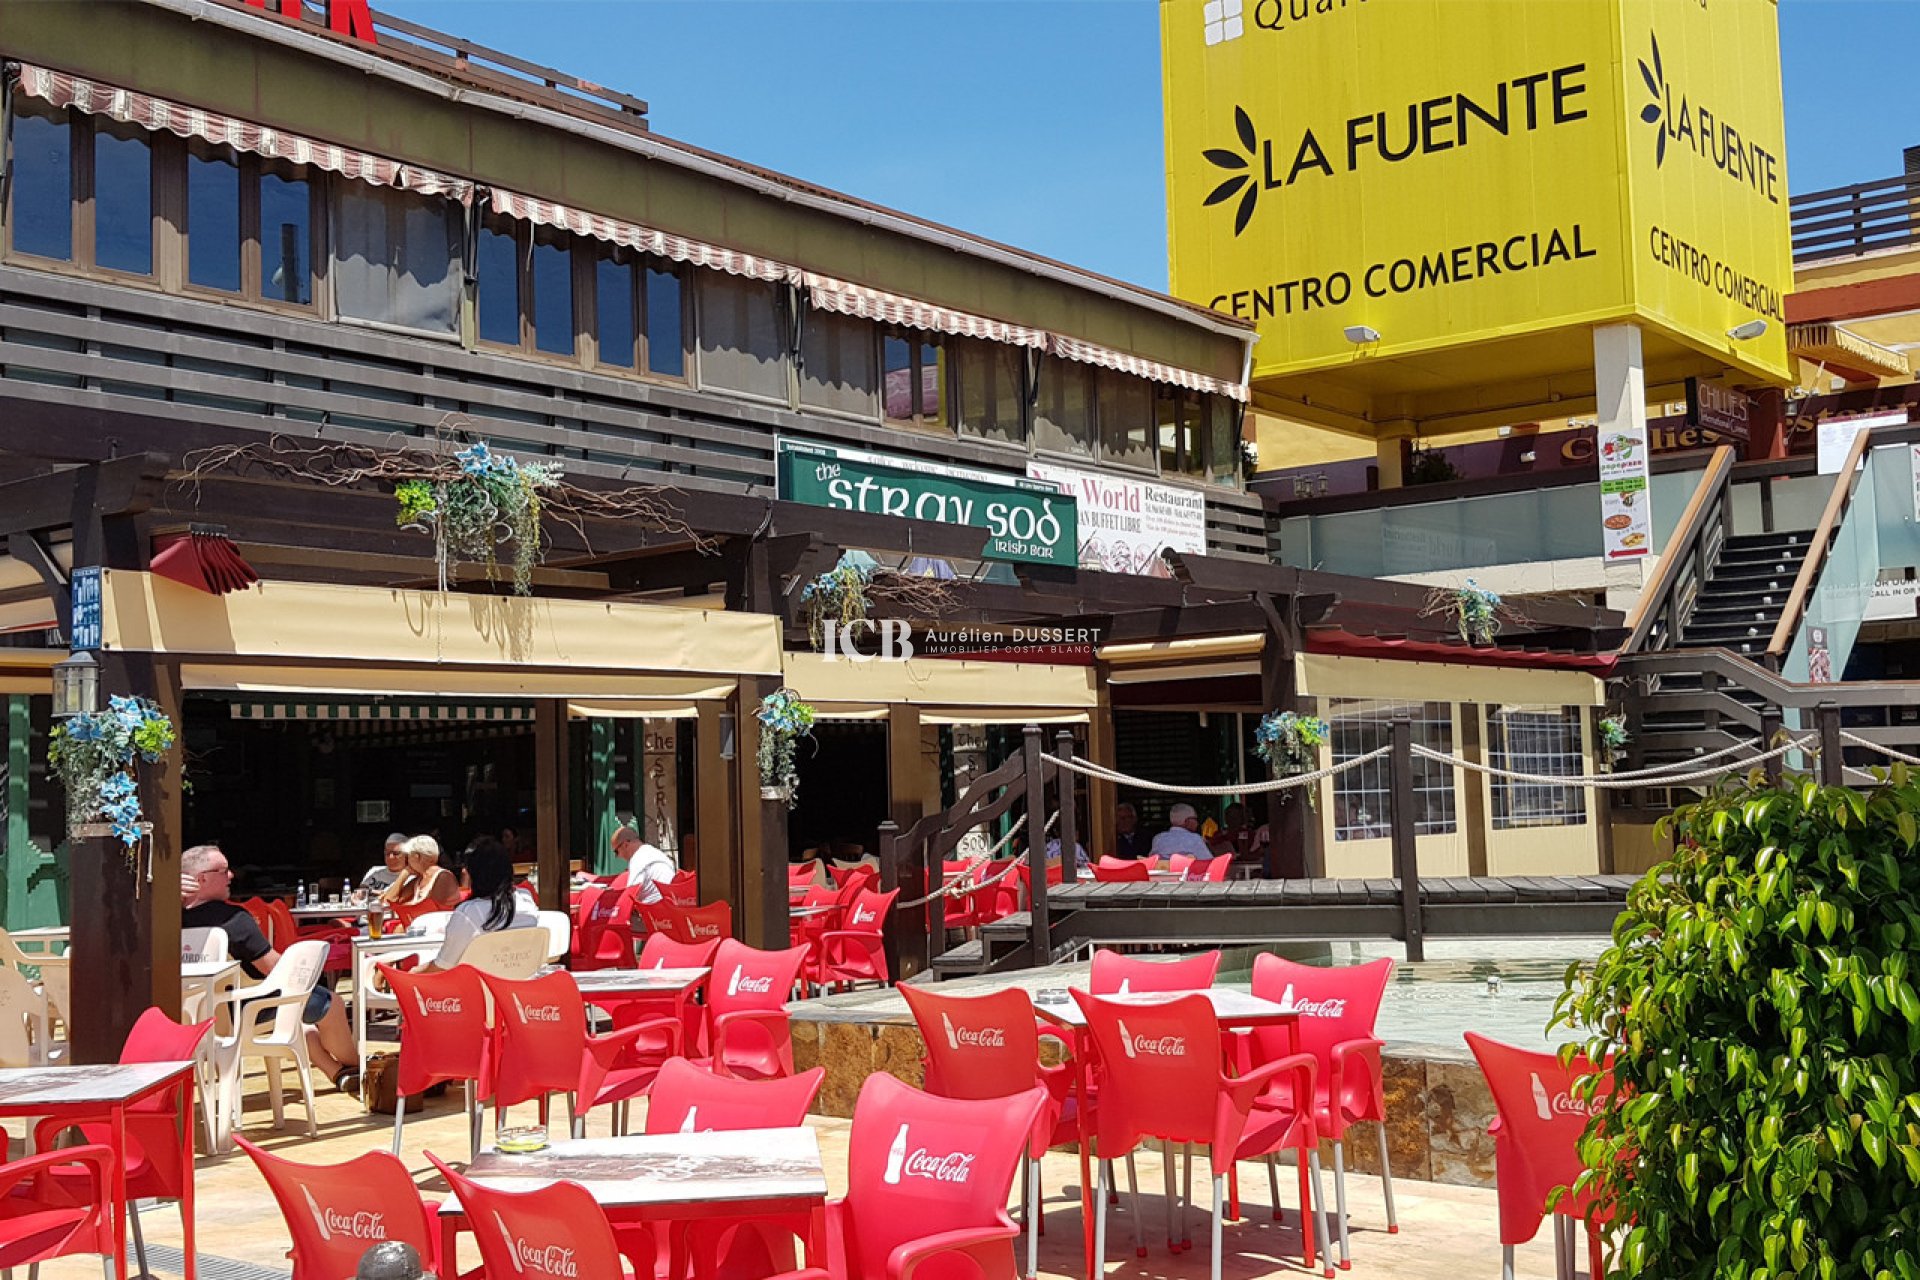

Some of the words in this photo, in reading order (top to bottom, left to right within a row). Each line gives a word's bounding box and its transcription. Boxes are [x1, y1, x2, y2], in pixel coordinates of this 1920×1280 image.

[1263, 127, 1332, 190] LA
[1347, 63, 1588, 171] FUENTE
[1666, 83, 1696, 150] LA
[1699, 106, 1778, 205] FUENTE
[1209, 271, 1350, 320] CENTRO
[1365, 225, 1597, 298] COMERCIAL
[1650, 226, 1710, 286] CENTRO
[1713, 260, 1784, 321] COMERCIAL
[815, 462, 841, 481] the
[1081, 478, 1141, 513] World
[1145, 486, 1203, 510] Restaurant
[1092, 510, 1119, 531] BUFFET
[1120, 514, 1141, 534] LIBRE
[738, 974, 773, 994] Coca-Cola
[426, 995, 462, 1014] Coca-Cola
[524, 1004, 562, 1022] Coca-Cola
[1295, 996, 1348, 1018] Coca-Cola
[956, 1025, 1006, 1048] Coca-Cola
[1133, 1033, 1187, 1057] Coca-Cola
[905, 1146, 977, 1184] Coca-Cola
[324, 1206, 387, 1241] Coca-Cola
[516, 1237, 579, 1279] Coca-Cola
